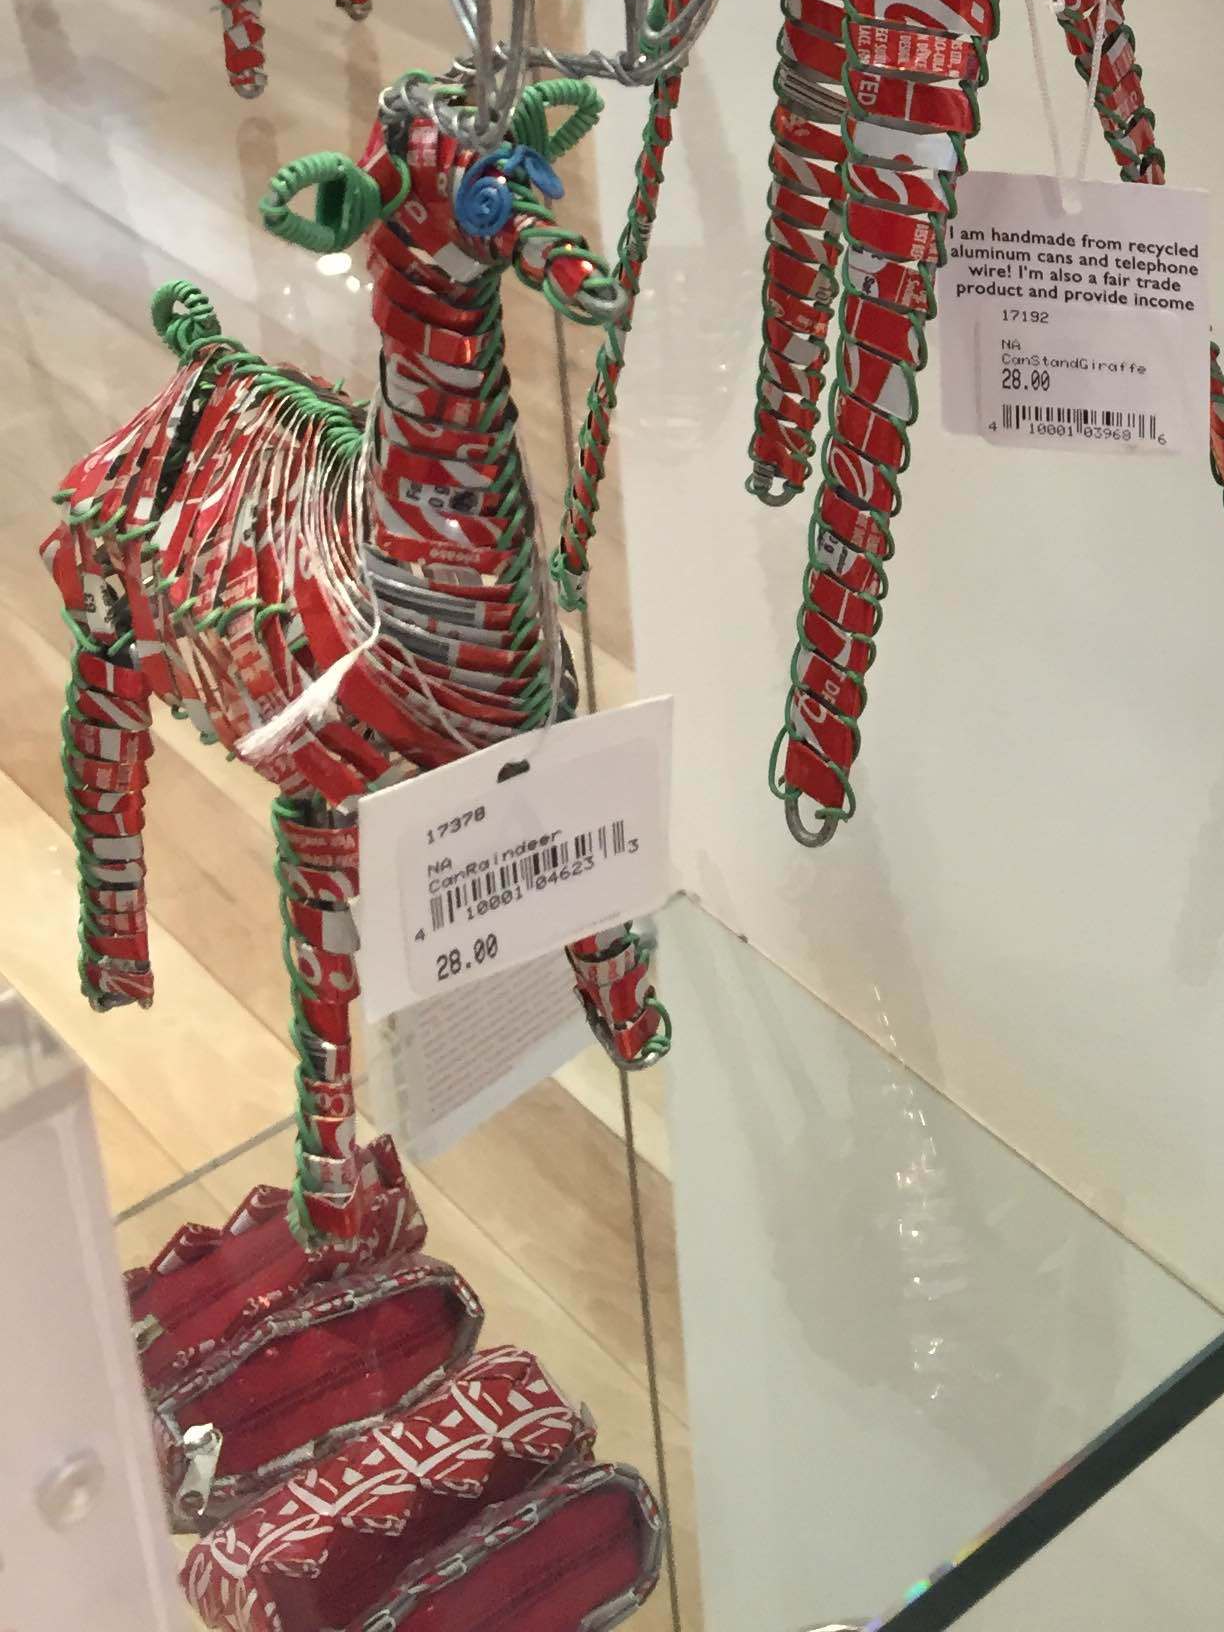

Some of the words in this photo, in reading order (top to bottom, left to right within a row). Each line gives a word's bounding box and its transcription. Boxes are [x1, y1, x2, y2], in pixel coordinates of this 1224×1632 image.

[950, 226, 954, 239] I
[961, 228, 985, 241] am
[992, 228, 1076, 247] handmade
[1082, 234, 1122, 251] from
[1129, 238, 1199, 258] recycled
[950, 245, 1031, 262] aluminum
[1037, 251, 1073, 265] cans
[1079, 250, 1108, 267] and
[1114, 256, 1199, 276] telephone
[968, 264, 1011, 278] wire!
[1018, 266, 1044, 280] I'm
[1050, 268, 1083, 284] also
[1088, 273, 1097, 285] a
[1103, 272, 1130, 287] fair
[1136, 275, 1182, 292] trade
[956, 281, 1023, 298] product
[1029, 283, 1058, 299] and
[1064, 287, 1128, 305] provide
[1134, 294, 1195, 311] income
[1002, 309, 1049, 323] 17192
[1001, 339, 1021, 351] NA
[1002, 354, 1147, 375] CanStandGiraffe
[1002, 368, 1051, 391] 28.00
[988, 421, 997, 431] 4
[1029, 423, 1073, 437] 10001
[1083, 426, 1131, 441] 03968
[1157, 433, 1167, 446] 6
[427, 806, 486, 845] 17378
[427, 857, 453, 878] NA
[429, 829, 563, 895] CanRaindeer
[465, 886, 523, 920] 10001
[535, 855, 595, 890] 04623
[628, 839, 640, 854] 3
[436, 933, 499, 981] 28.00
